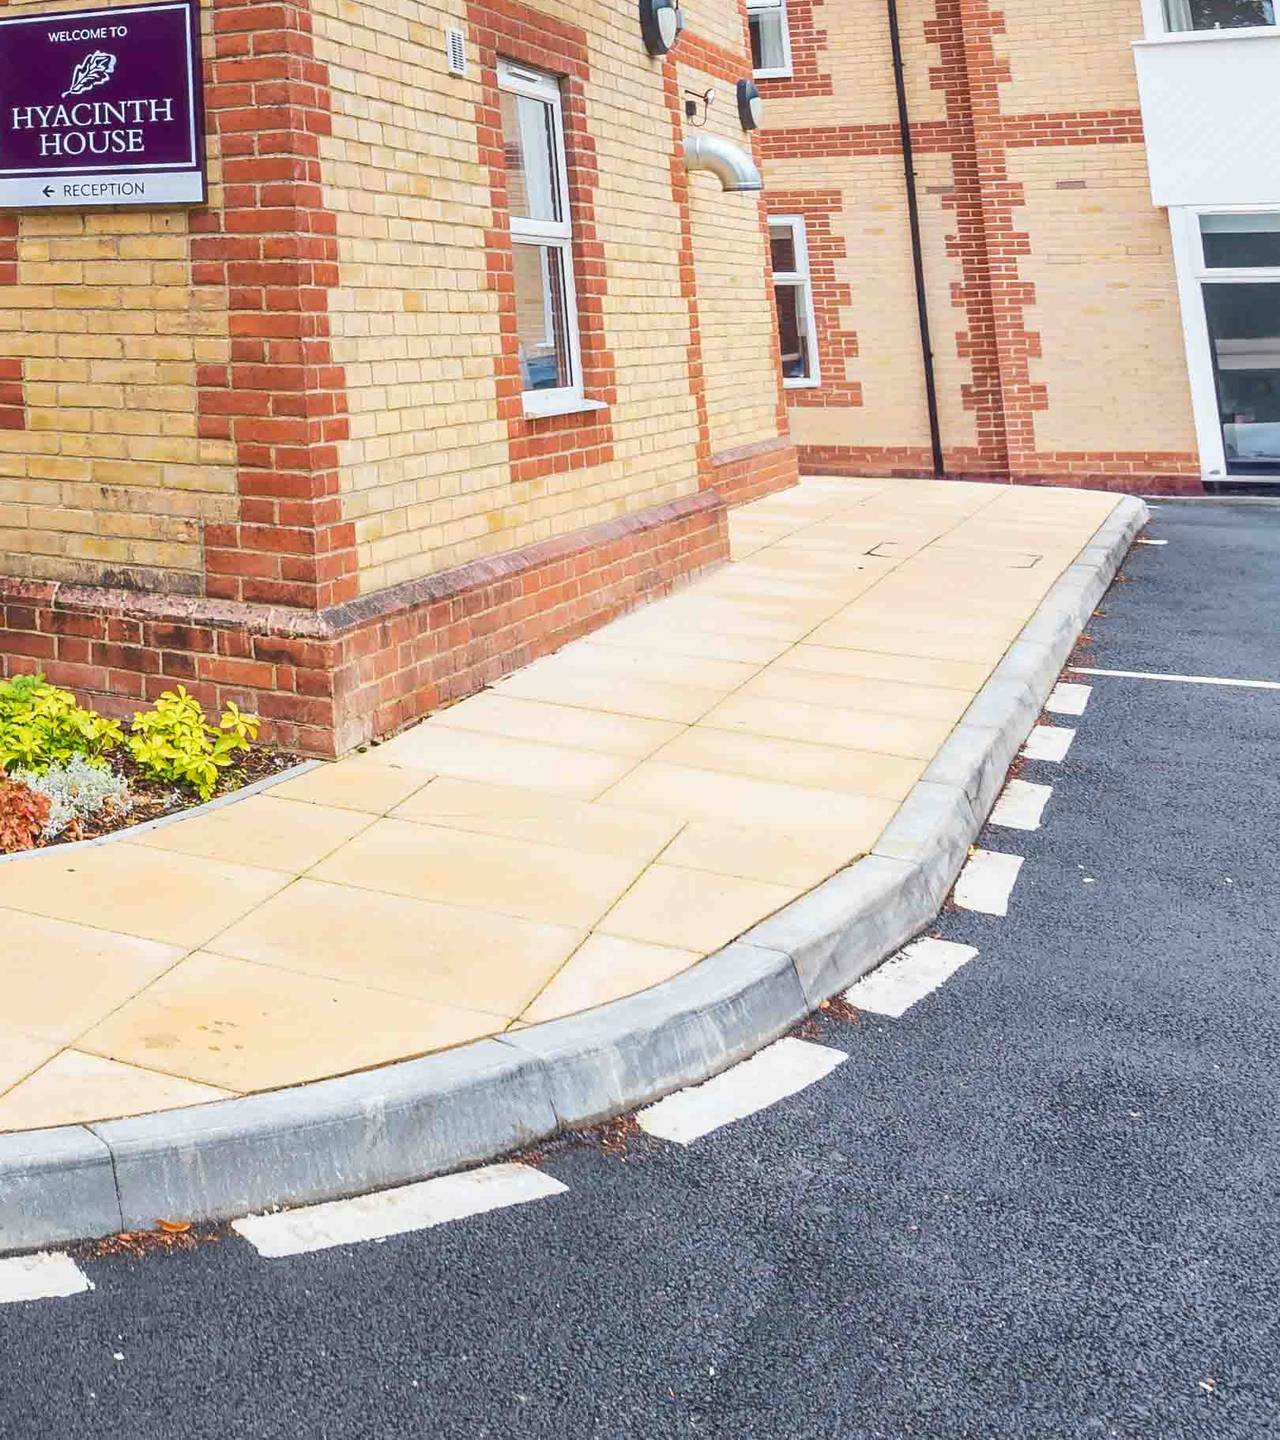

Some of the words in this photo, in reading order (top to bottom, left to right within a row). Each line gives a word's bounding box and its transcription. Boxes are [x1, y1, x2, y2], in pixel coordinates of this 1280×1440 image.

[48, 29, 107, 42] WELCOME
[109, 26, 128, 37] TO
[12, 98, 174, 129] HYACINTH
[39, 129, 145, 156] HOUSE
[63, 182, 145, 197] RECEPTION
